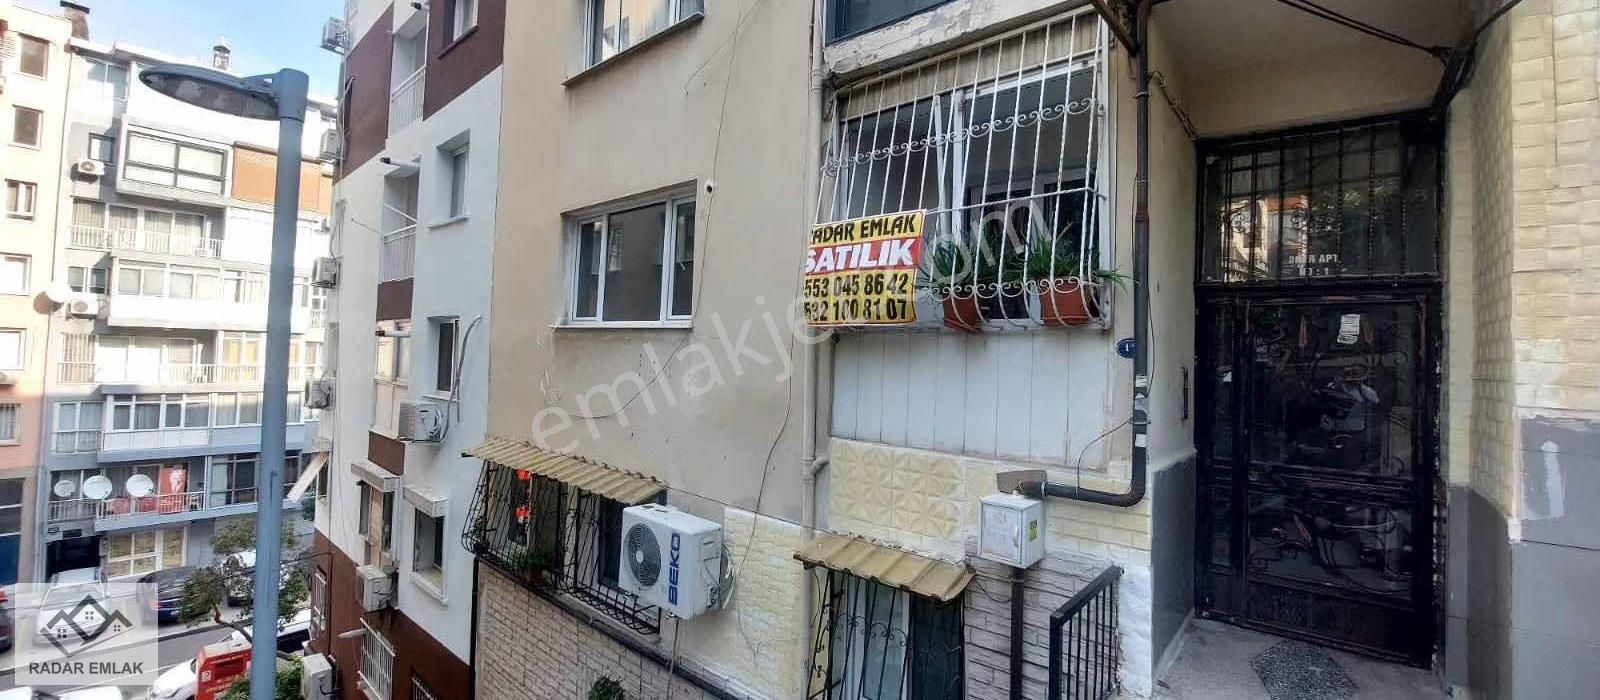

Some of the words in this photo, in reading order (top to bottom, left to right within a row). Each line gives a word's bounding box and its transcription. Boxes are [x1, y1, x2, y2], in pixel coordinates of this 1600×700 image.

[860, 214, 916, 238] EMLAK
[805, 239, 916, 272] SATILIK
[834, 275, 859, 296] 045
[864, 273, 884, 295] 86
[887, 273, 909, 294] 42
[833, 299, 859, 320] 100
[863, 299, 881, 320] 81
[887, 299, 907, 320] 07
[668, 532, 681, 606] BEKO
